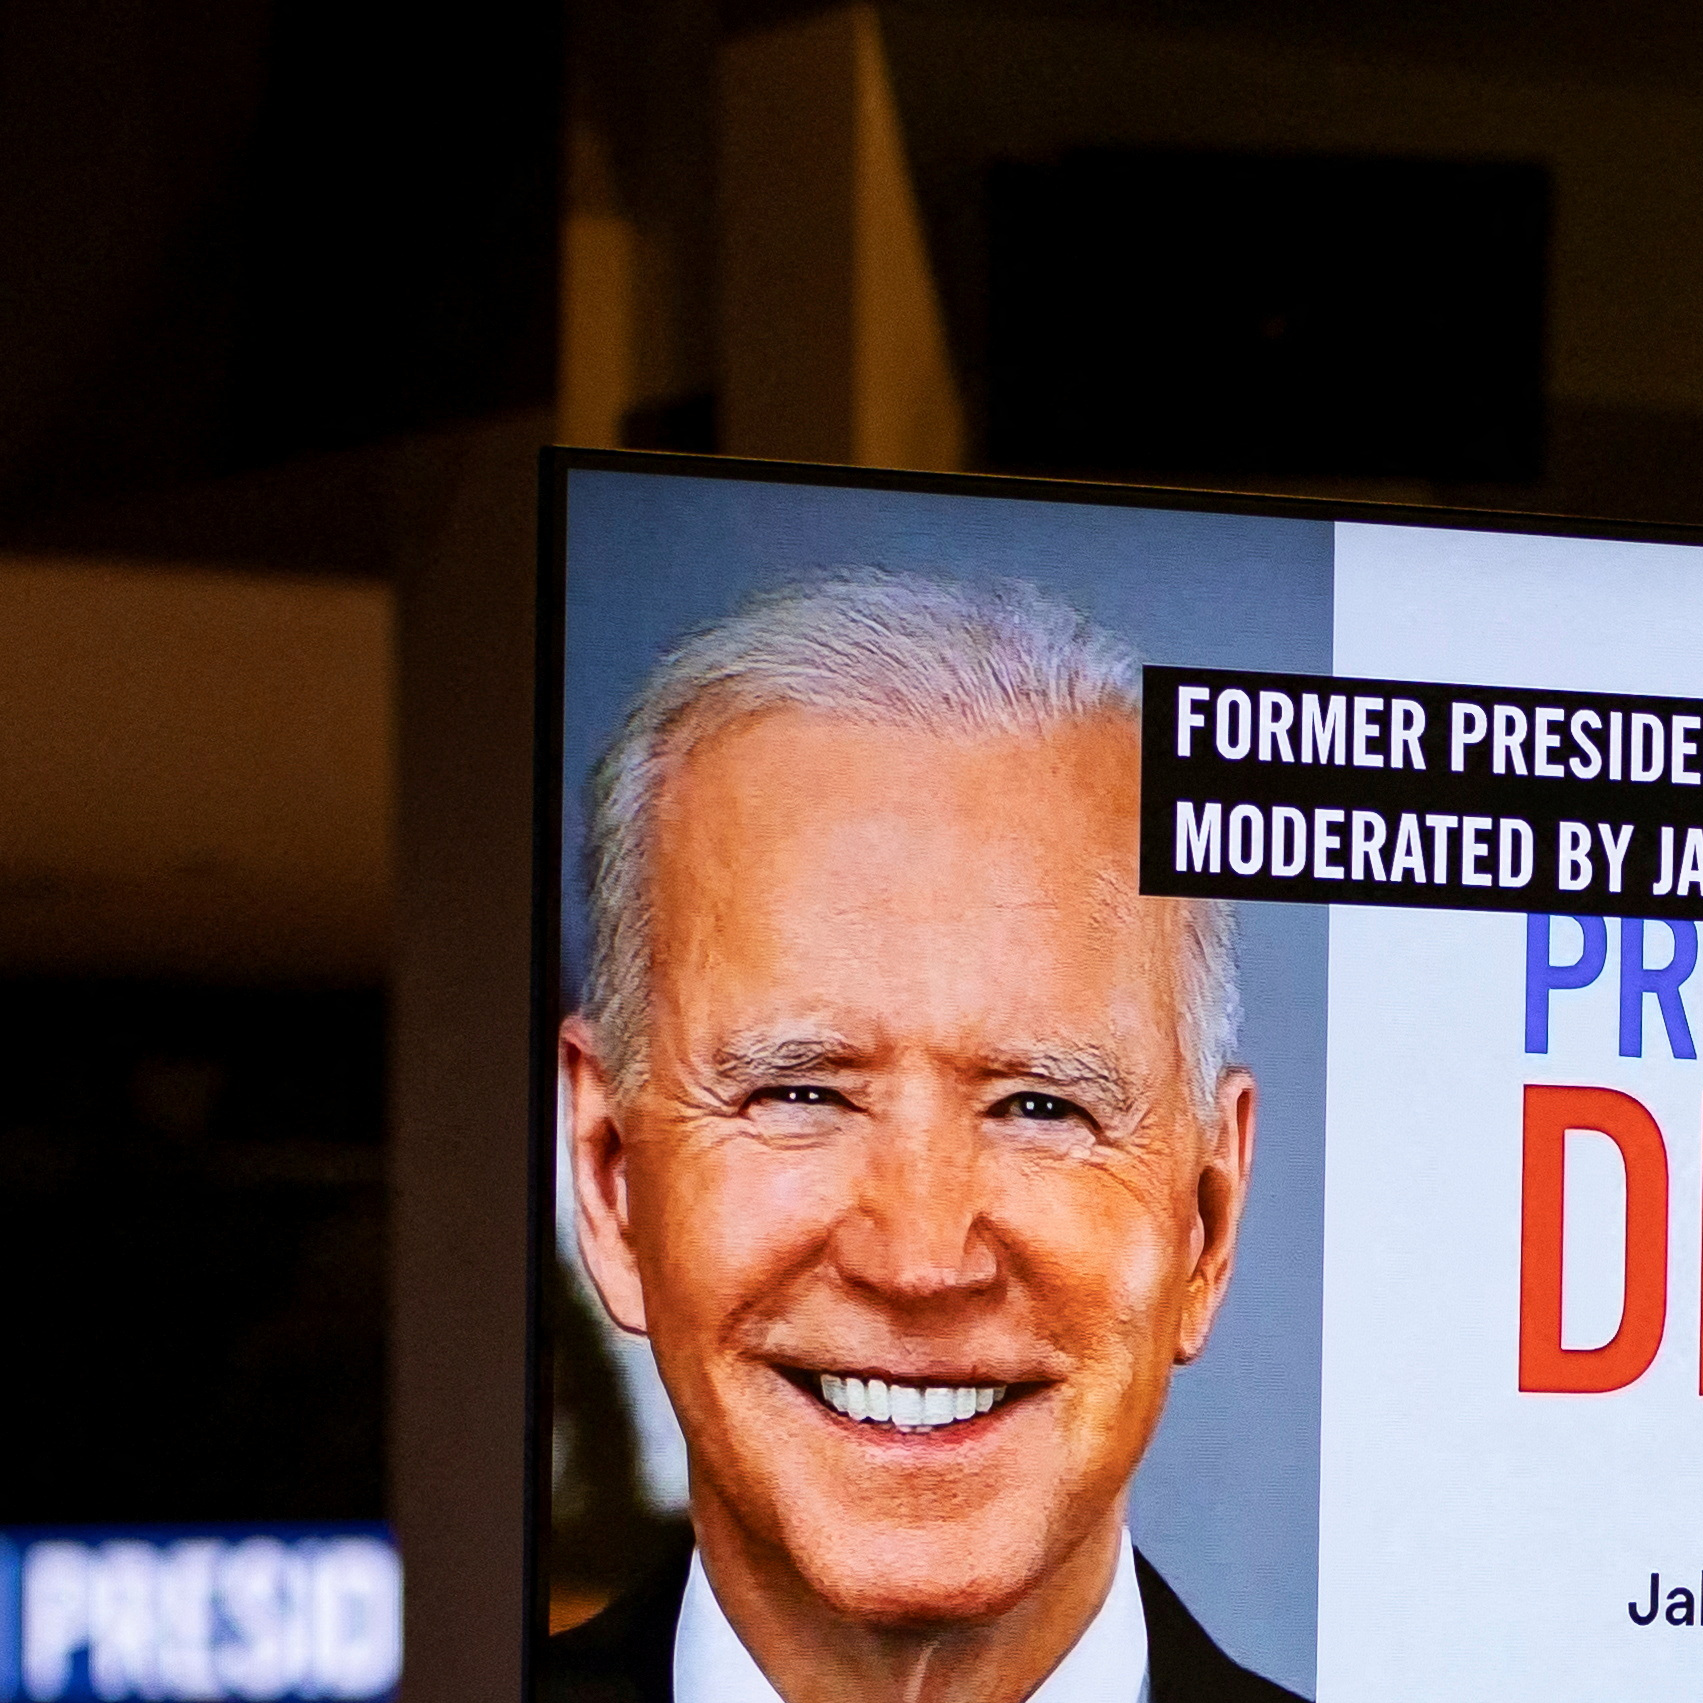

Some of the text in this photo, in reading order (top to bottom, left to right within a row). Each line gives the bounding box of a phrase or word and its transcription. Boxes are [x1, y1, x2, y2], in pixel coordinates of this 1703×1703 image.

[1176, 685, 1427, 770] FORMER
[1174, 801, 1534, 888] MODERATED
[1558, 821, 1635, 893] BY
